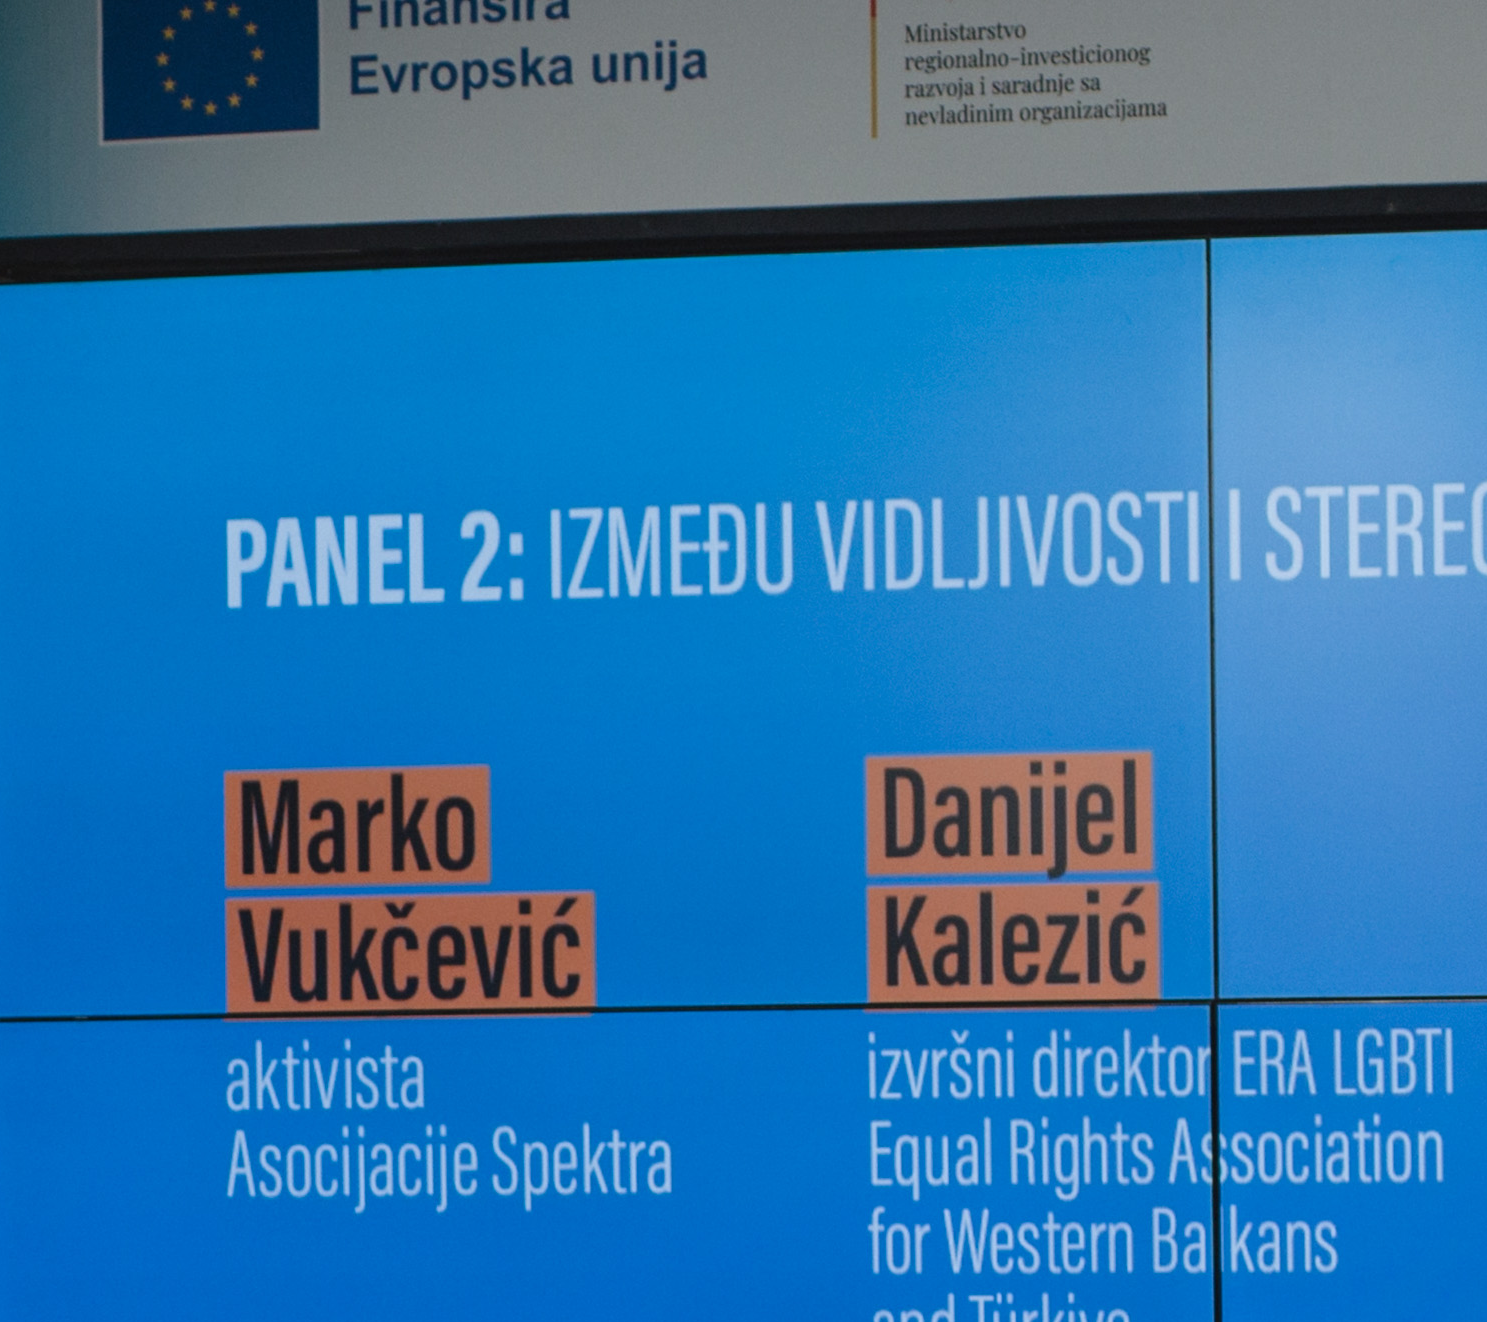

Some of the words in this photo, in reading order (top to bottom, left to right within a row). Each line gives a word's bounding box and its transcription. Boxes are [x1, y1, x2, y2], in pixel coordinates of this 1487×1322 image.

[350, 0, 570, 30] Finansira
[905, 23, 1026, 43] Ministarstvo
[350, 47, 573, 100] Evropska
[592, 40, 707, 91] unija
[905, 45, 1151, 73] regionalno-investicionog
[905, 77, 974, 99] razvoja
[980, 76, 985, 95] i
[992, 73, 1074, 96] saradnje
[1080, 76, 1101, 91] sa
[905, 105, 1014, 125] nevladinim
[1020, 99, 1168, 124] organizacijama
[226, 514, 445, 608] PANEL
[461, 511, 523, 601] 2:
[550, 502, 793, 599] IZMEĐU
[815, 490, 1200, 591] VIDLJIVOSTI
[1228, 488, 1242, 580] I
[241, 773, 476, 876] Marko
[881, 759, 1137, 878] Danijel
[237, 895, 581, 1003] Vukčević
[884, 885, 1146, 987] Kalezić
[226, 1039, 425, 1111] aktivista
[868, 1030, 1015, 1099] izvršni
[1032, 1029, 1210, 1098] direktor
[1233, 1029, 1317, 1097] ERA
[1333, 1028, 1454, 1097] LGBTI
[227, 1126, 478, 1213] Asocijacije
[492, 1123, 672, 1211] Spektra
[870, 1117, 992, 1200] Equal
[1010, 1116, 1155, 1200] Rights
[1168, 1114, 1444, 1184] Association
[868, 1206, 931, 1275] for
[943, 1209, 1134, 1274] Western
[1152, 1204, 1339, 1274] Bakans
